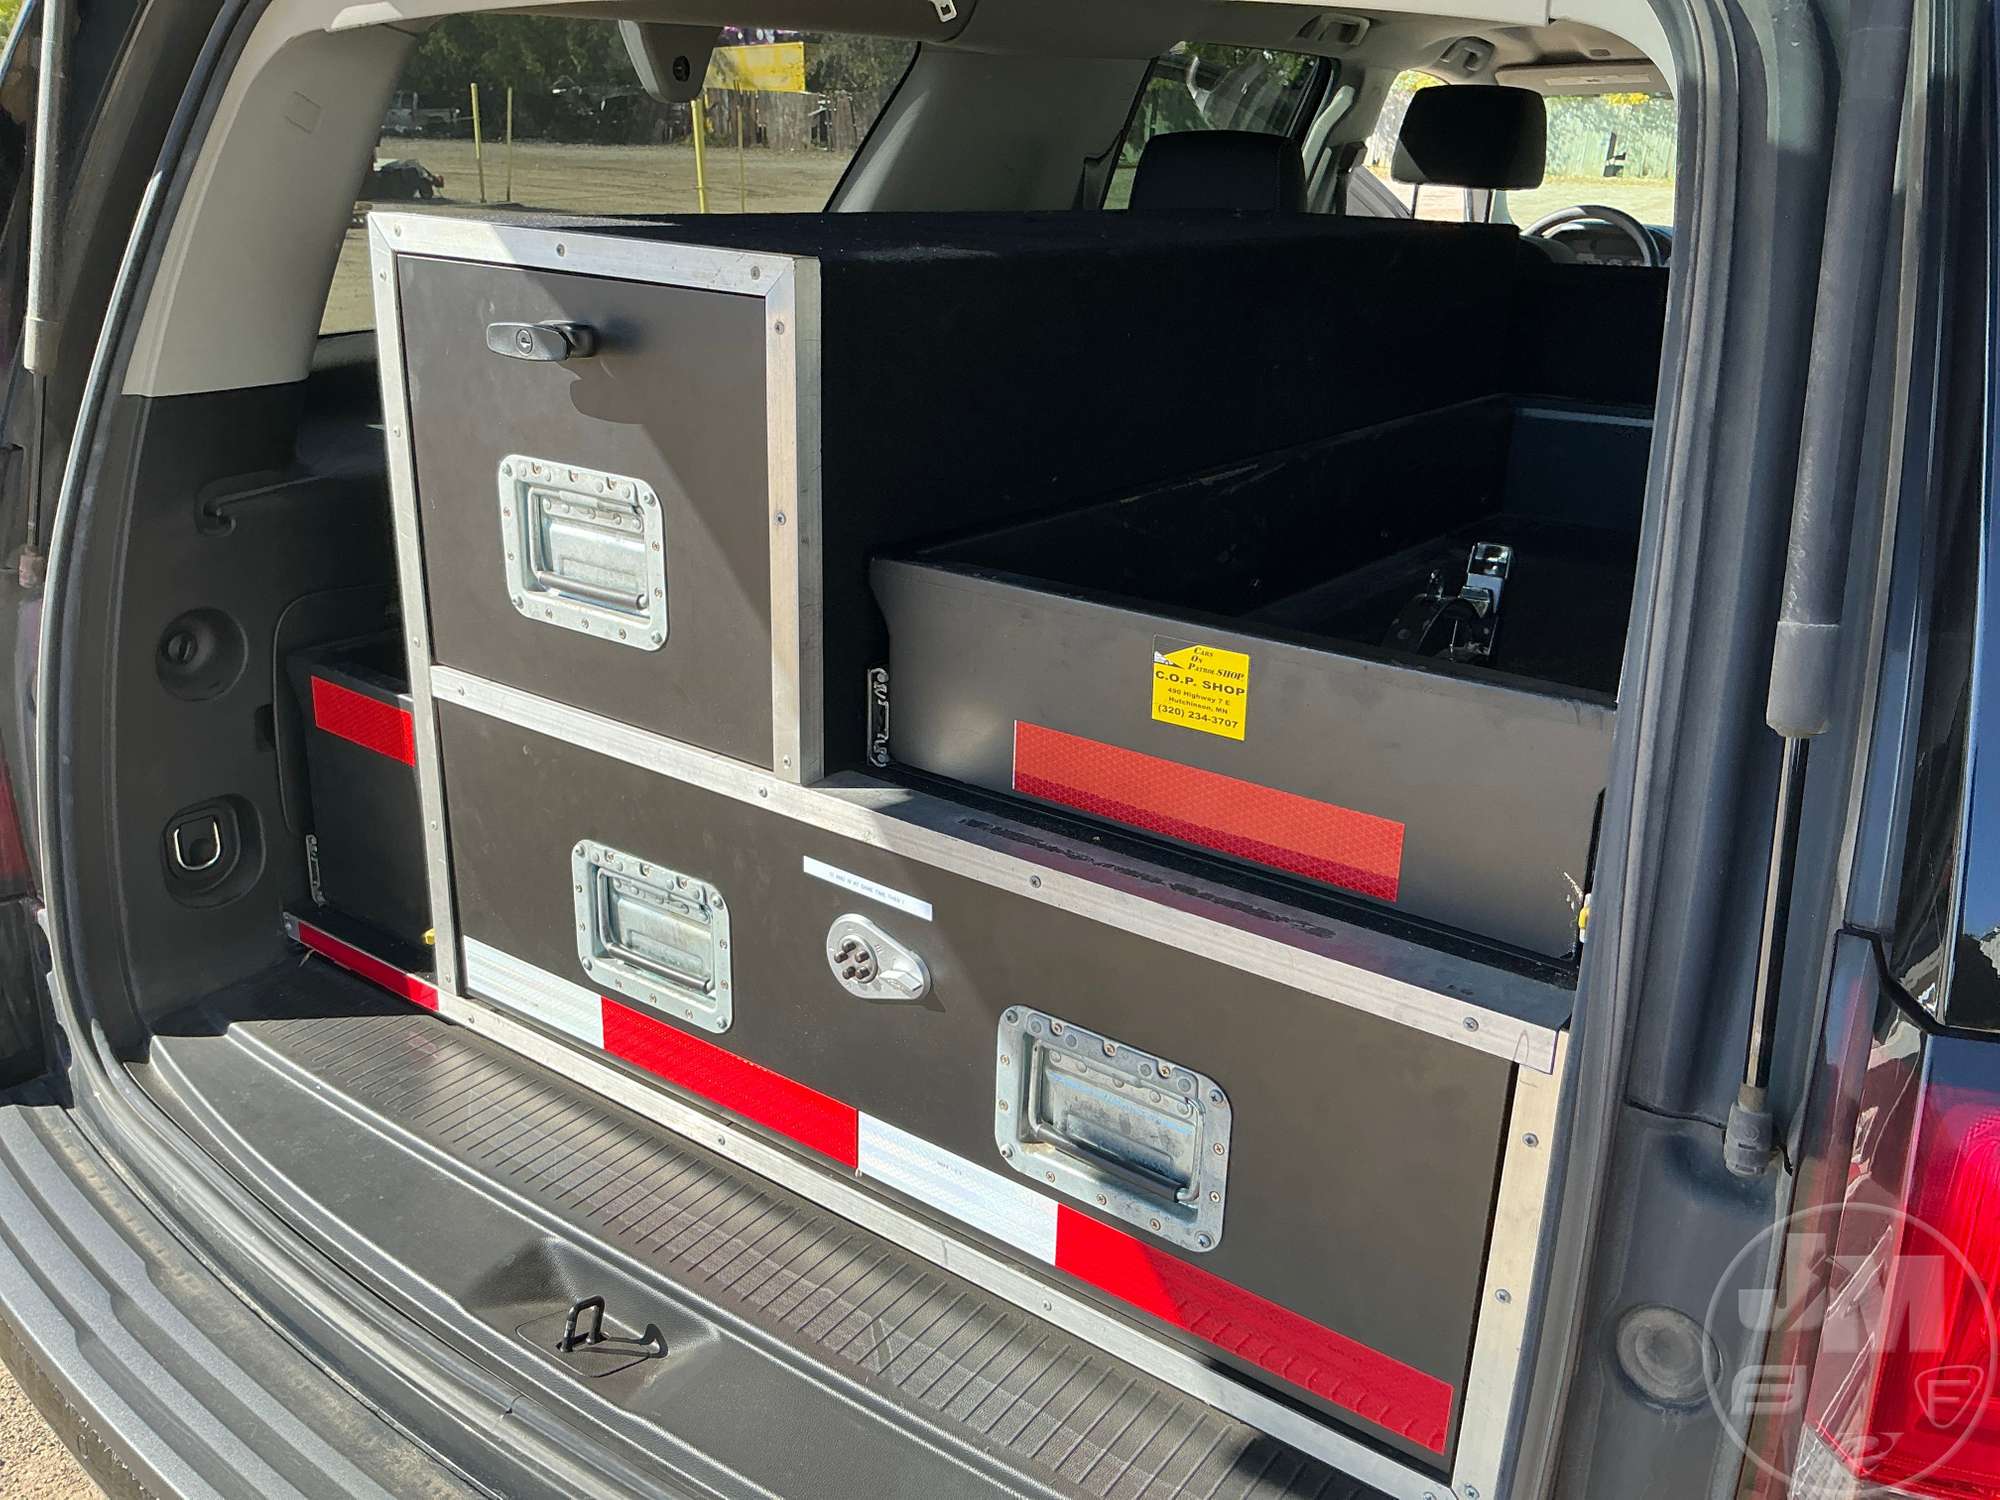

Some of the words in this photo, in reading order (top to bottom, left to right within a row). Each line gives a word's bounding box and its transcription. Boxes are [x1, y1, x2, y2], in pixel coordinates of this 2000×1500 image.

[1216, 669, 1245, 681] SHOP
[1155, 670, 1197, 687] C.O.P.
[1202, 680, 1245, 696] SHOP
[1168, 696, 1213, 711] Hutchinson,
[1183, 691, 1216, 703] Highway
[1158, 704, 1185, 718] (320)
[1188, 711, 1239, 729] 234-3707
